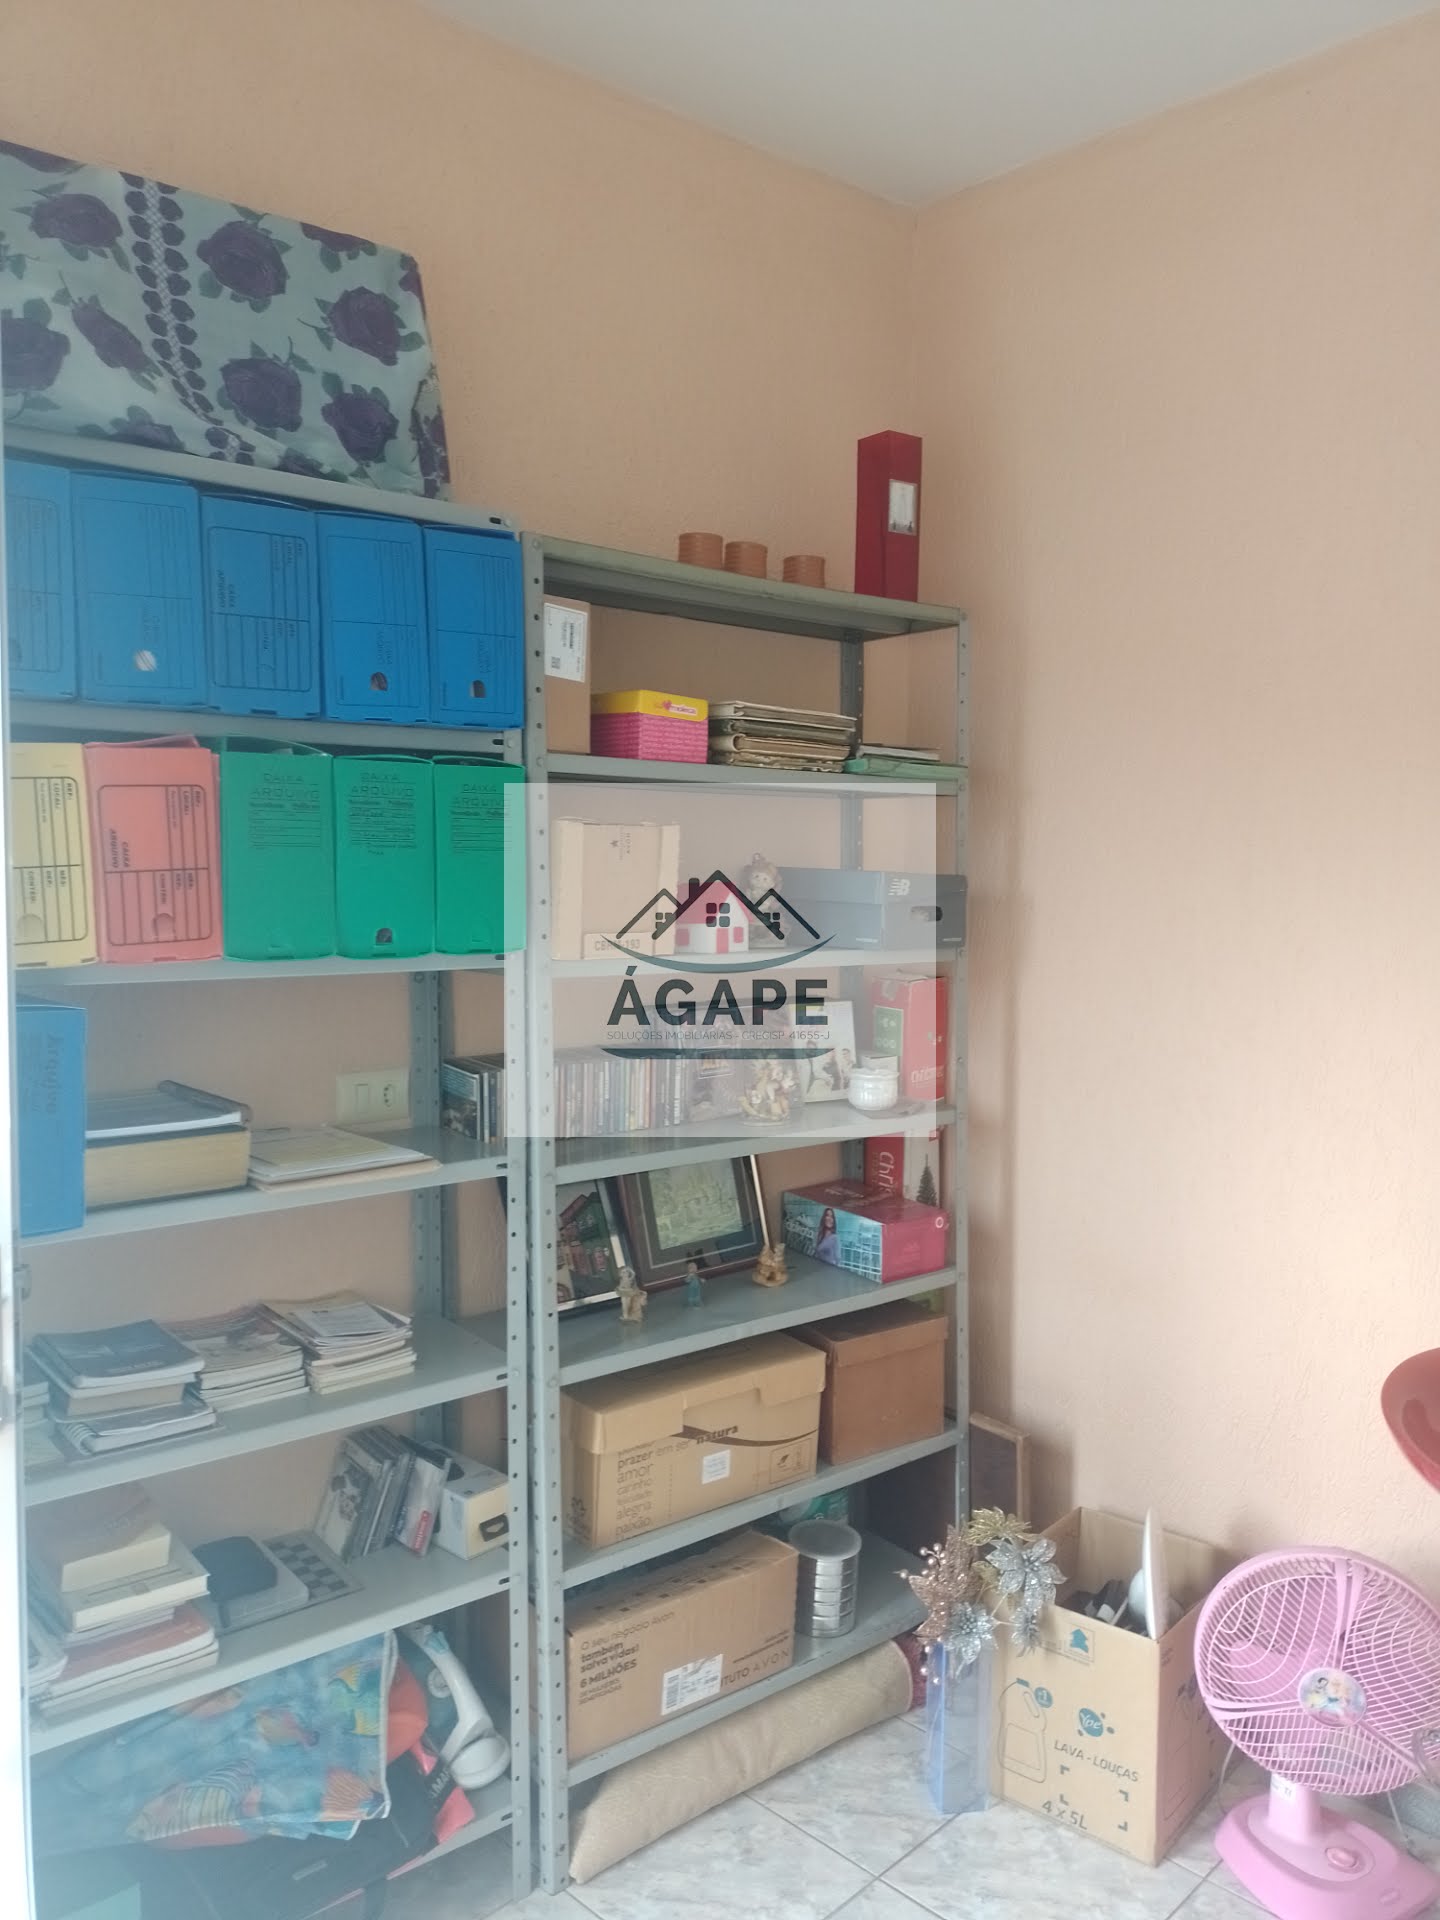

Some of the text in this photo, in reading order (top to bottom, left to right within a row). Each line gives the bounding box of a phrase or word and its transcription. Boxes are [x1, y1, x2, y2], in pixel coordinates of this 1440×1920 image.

[617, 1451, 654, 1472] prazer
[696, 1425, 739, 1445] natura
[616, 1463, 655, 1484] amor
[580, 1658, 639, 1689] 6 MILHÕES
[752, 1648, 790, 1672] AVON
[1053, 1739, 1085, 1761] LAVA
[1092, 1755, 1140, 1783] LOUÇAS
[1042, 1799, 1054, 1814] 4
[1069, 1810, 1089, 1831] 5L
